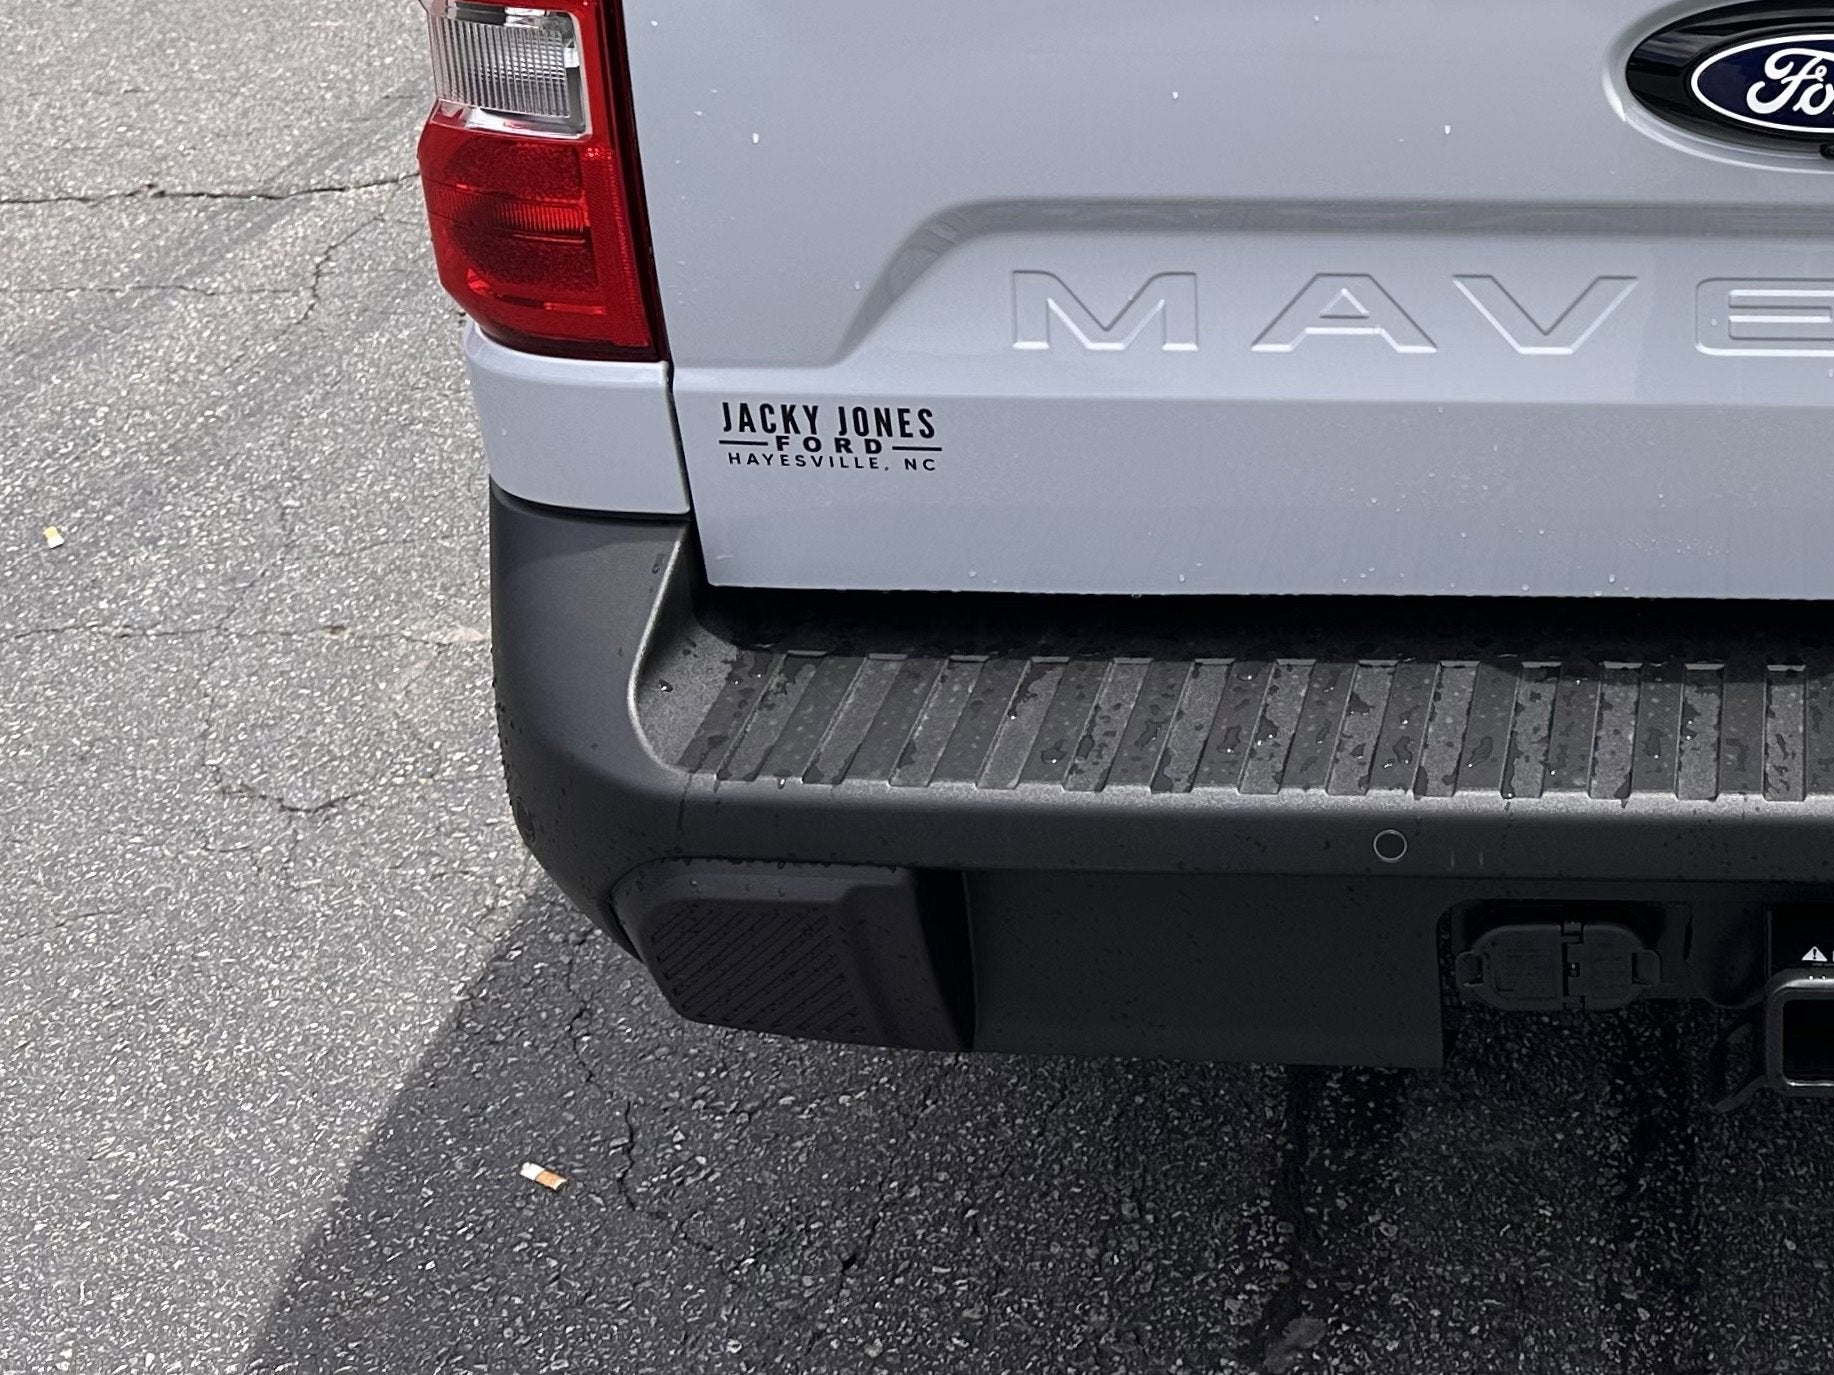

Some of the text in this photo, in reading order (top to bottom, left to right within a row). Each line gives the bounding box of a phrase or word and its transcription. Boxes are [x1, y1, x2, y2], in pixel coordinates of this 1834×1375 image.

[721, 401, 936, 439] JACKY JONES
[775, 435, 883, 455] FORD
[728, 452, 937, 472] HAYESVILLE, NC
